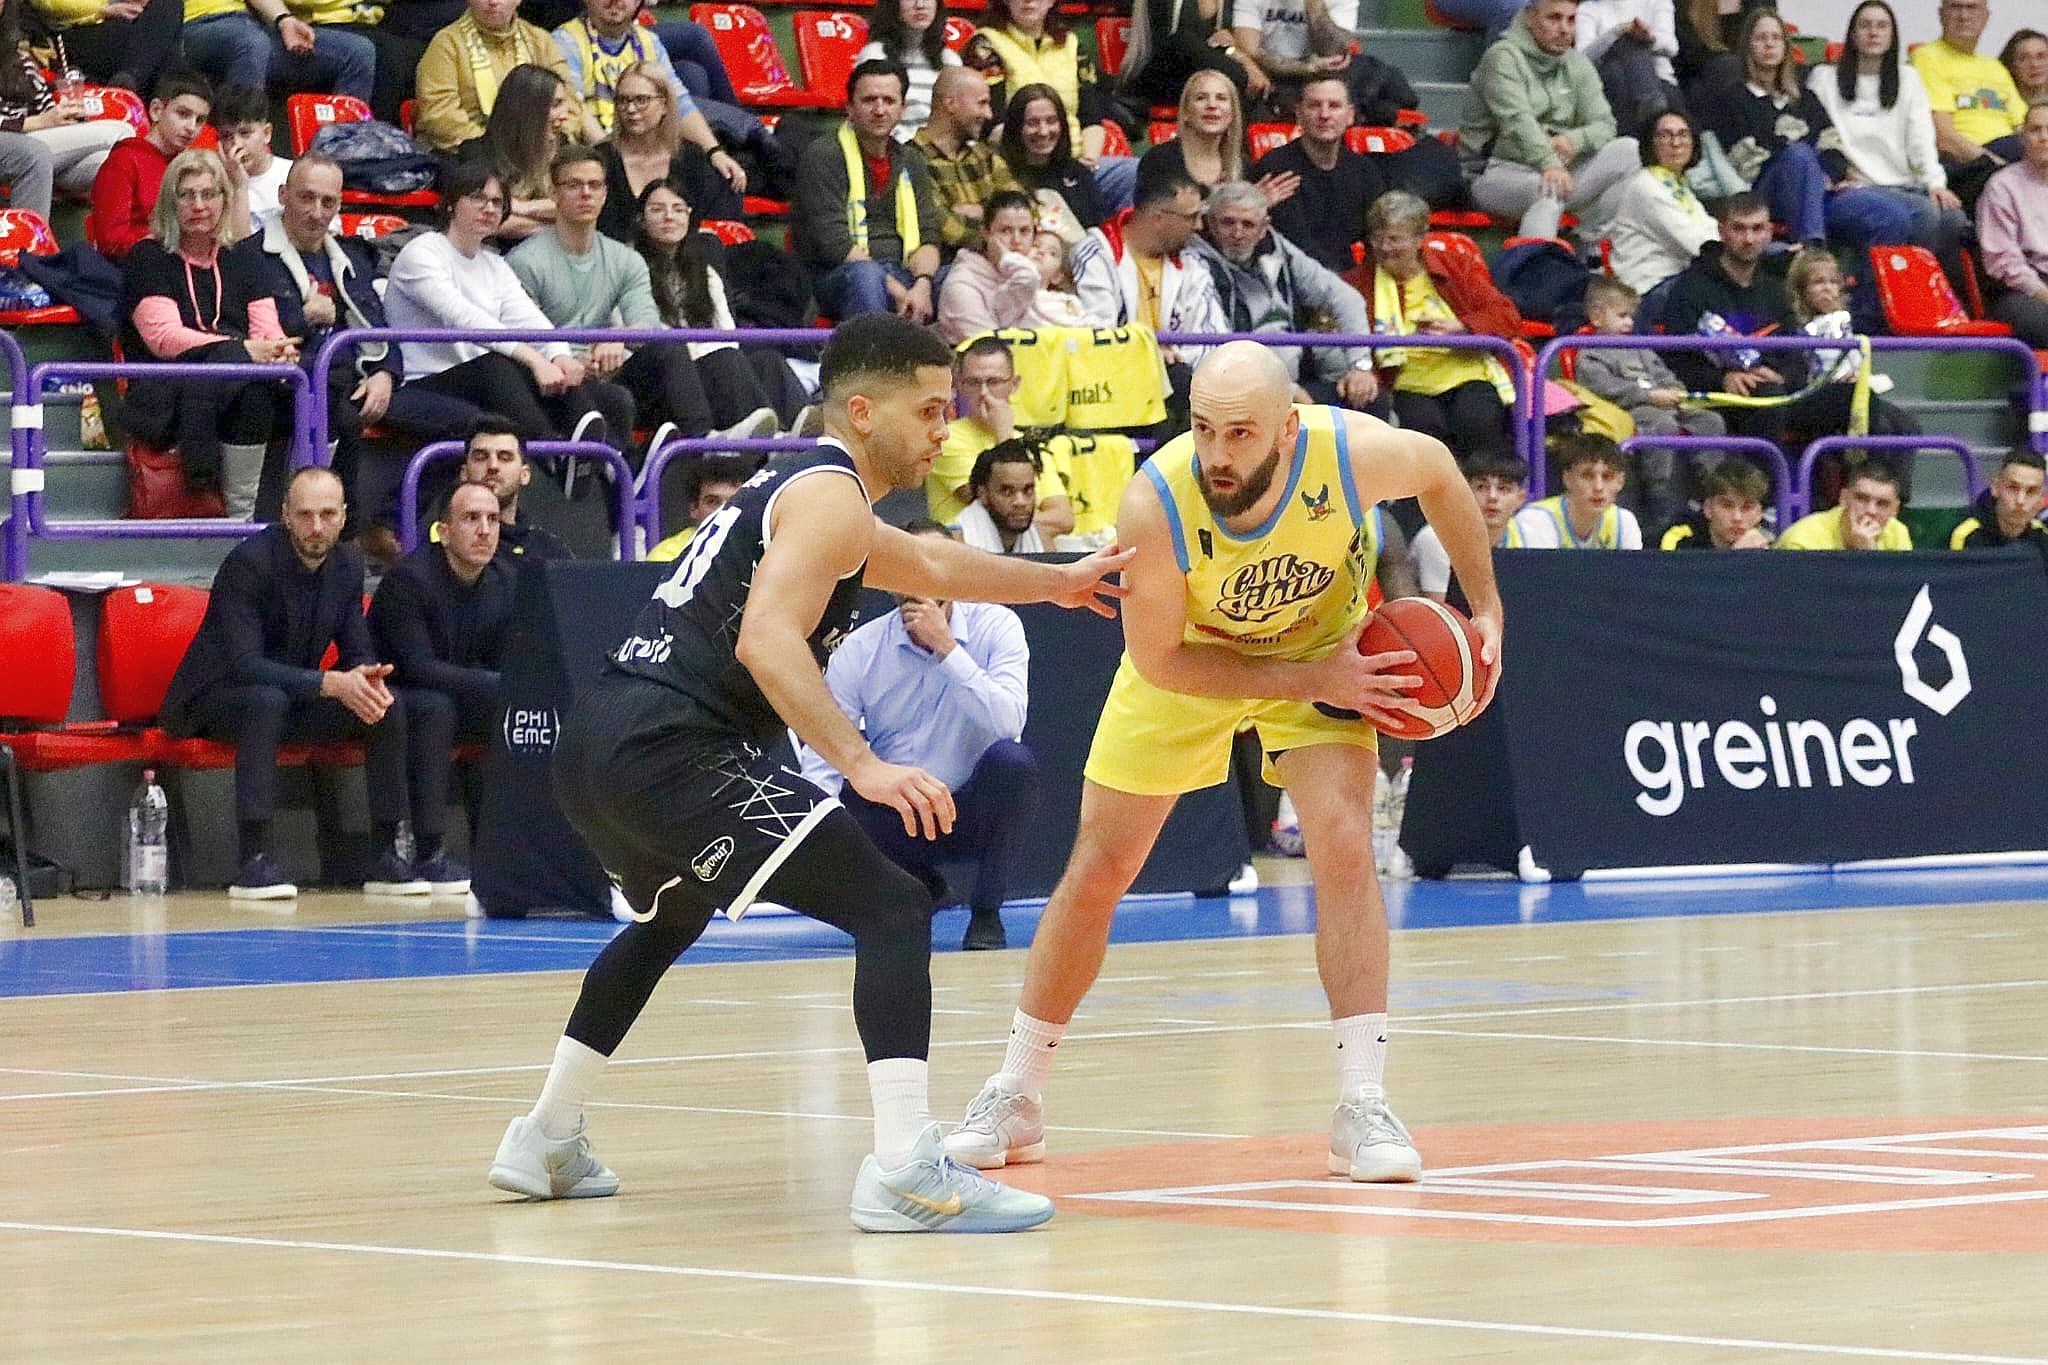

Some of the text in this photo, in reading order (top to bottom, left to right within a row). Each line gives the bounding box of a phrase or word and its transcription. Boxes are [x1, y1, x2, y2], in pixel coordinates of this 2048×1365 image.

[515, 710, 547, 727] PHI
[512, 727, 551, 745] EMC
[1624, 695, 1918, 816] greiner
